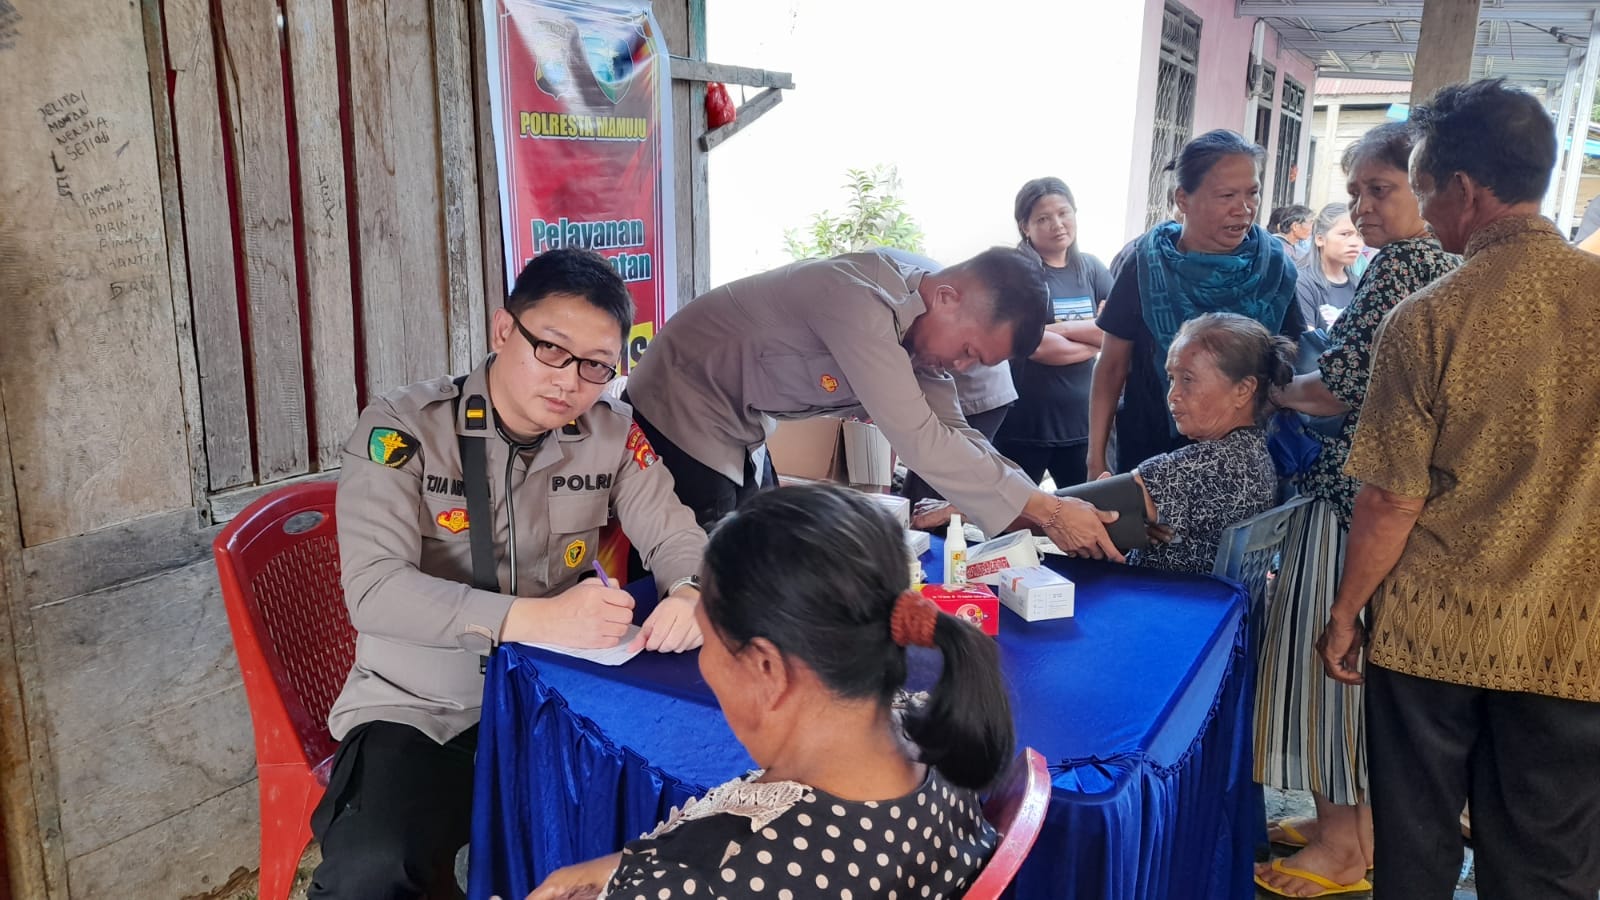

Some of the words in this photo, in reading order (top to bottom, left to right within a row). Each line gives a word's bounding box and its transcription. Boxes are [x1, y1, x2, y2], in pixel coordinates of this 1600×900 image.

[520, 111, 594, 138] POLRESTA
[595, 116, 648, 140] MAMUJU
[531, 217, 645, 251] Pelayanan
[427, 475, 449, 495] TJIA
[552, 473, 612, 492] POLRI
